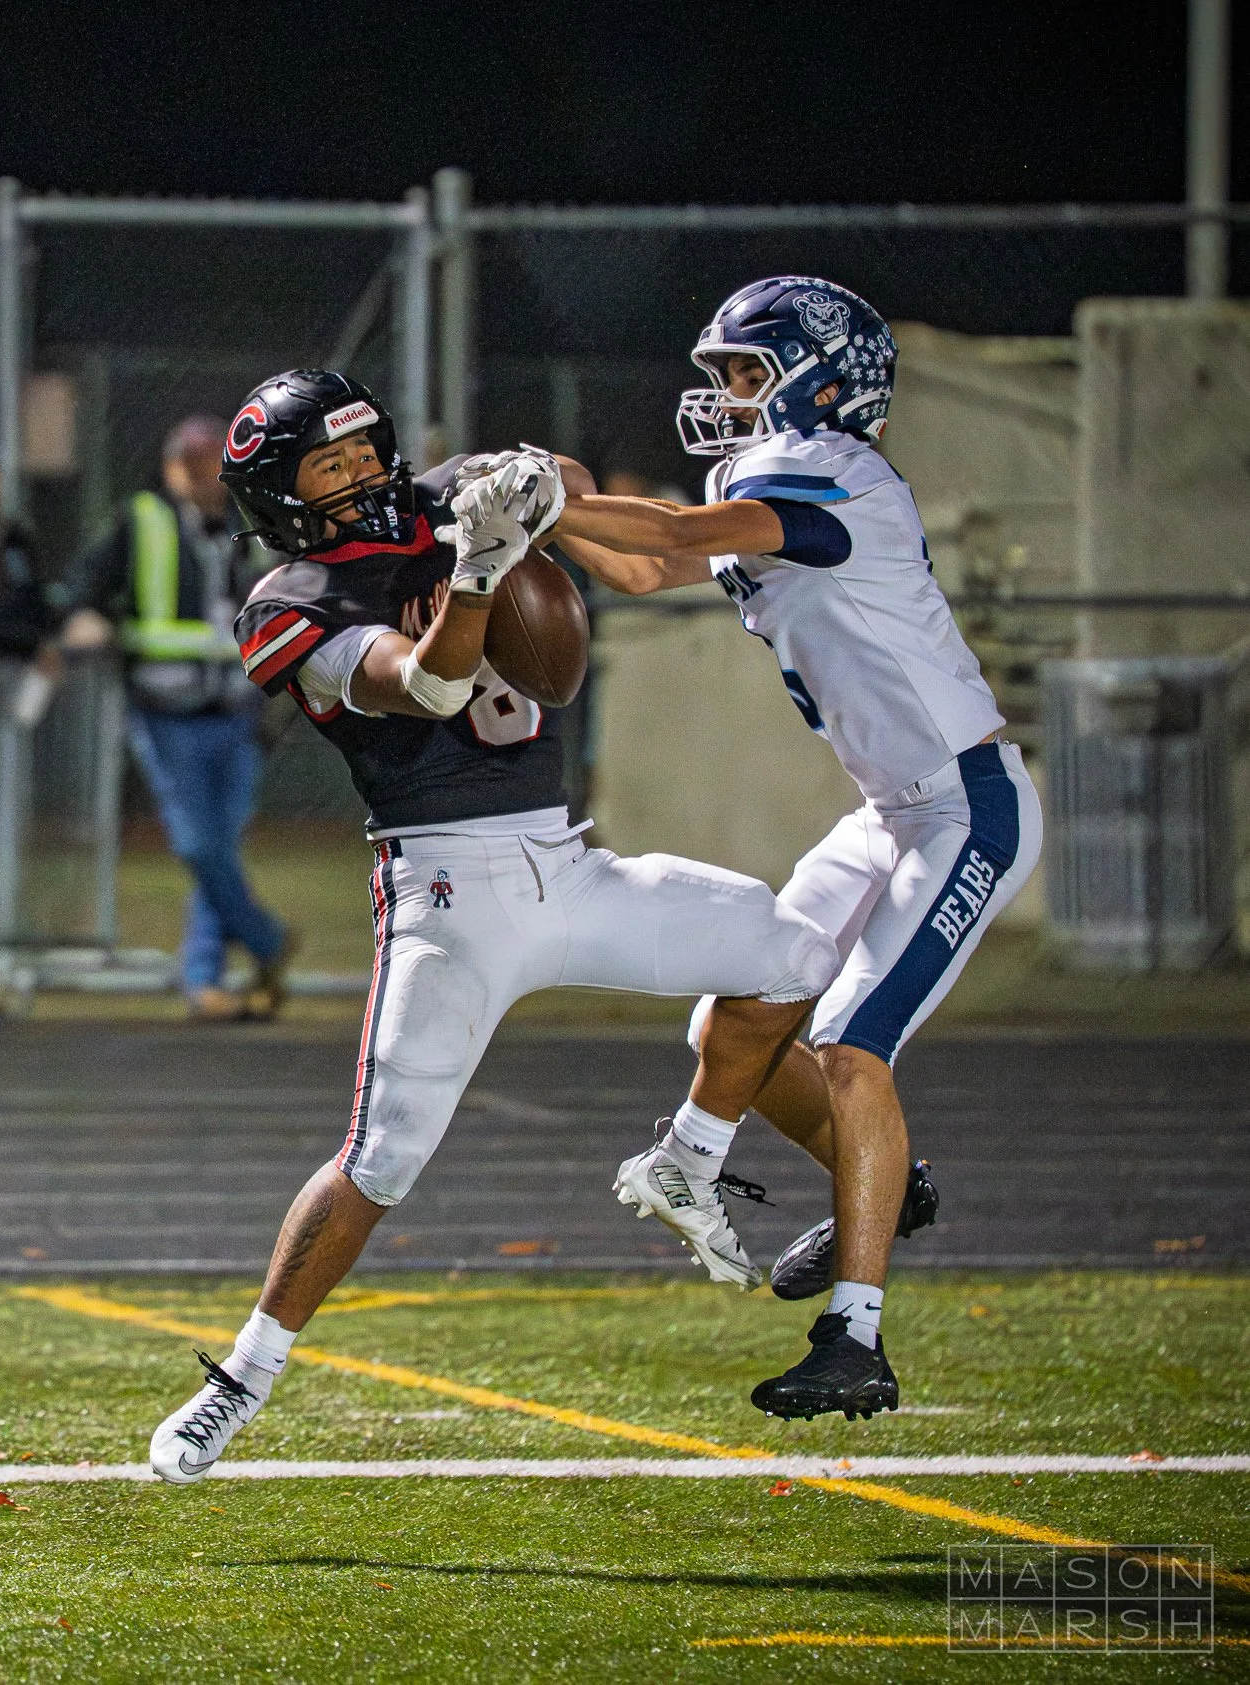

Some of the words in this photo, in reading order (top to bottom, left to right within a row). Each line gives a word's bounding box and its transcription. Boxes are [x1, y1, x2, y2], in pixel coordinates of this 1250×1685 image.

[329, 405, 372, 429] Riddell
[930, 848, 995, 951] BEARS
[652, 1165, 697, 1209] NIKE
